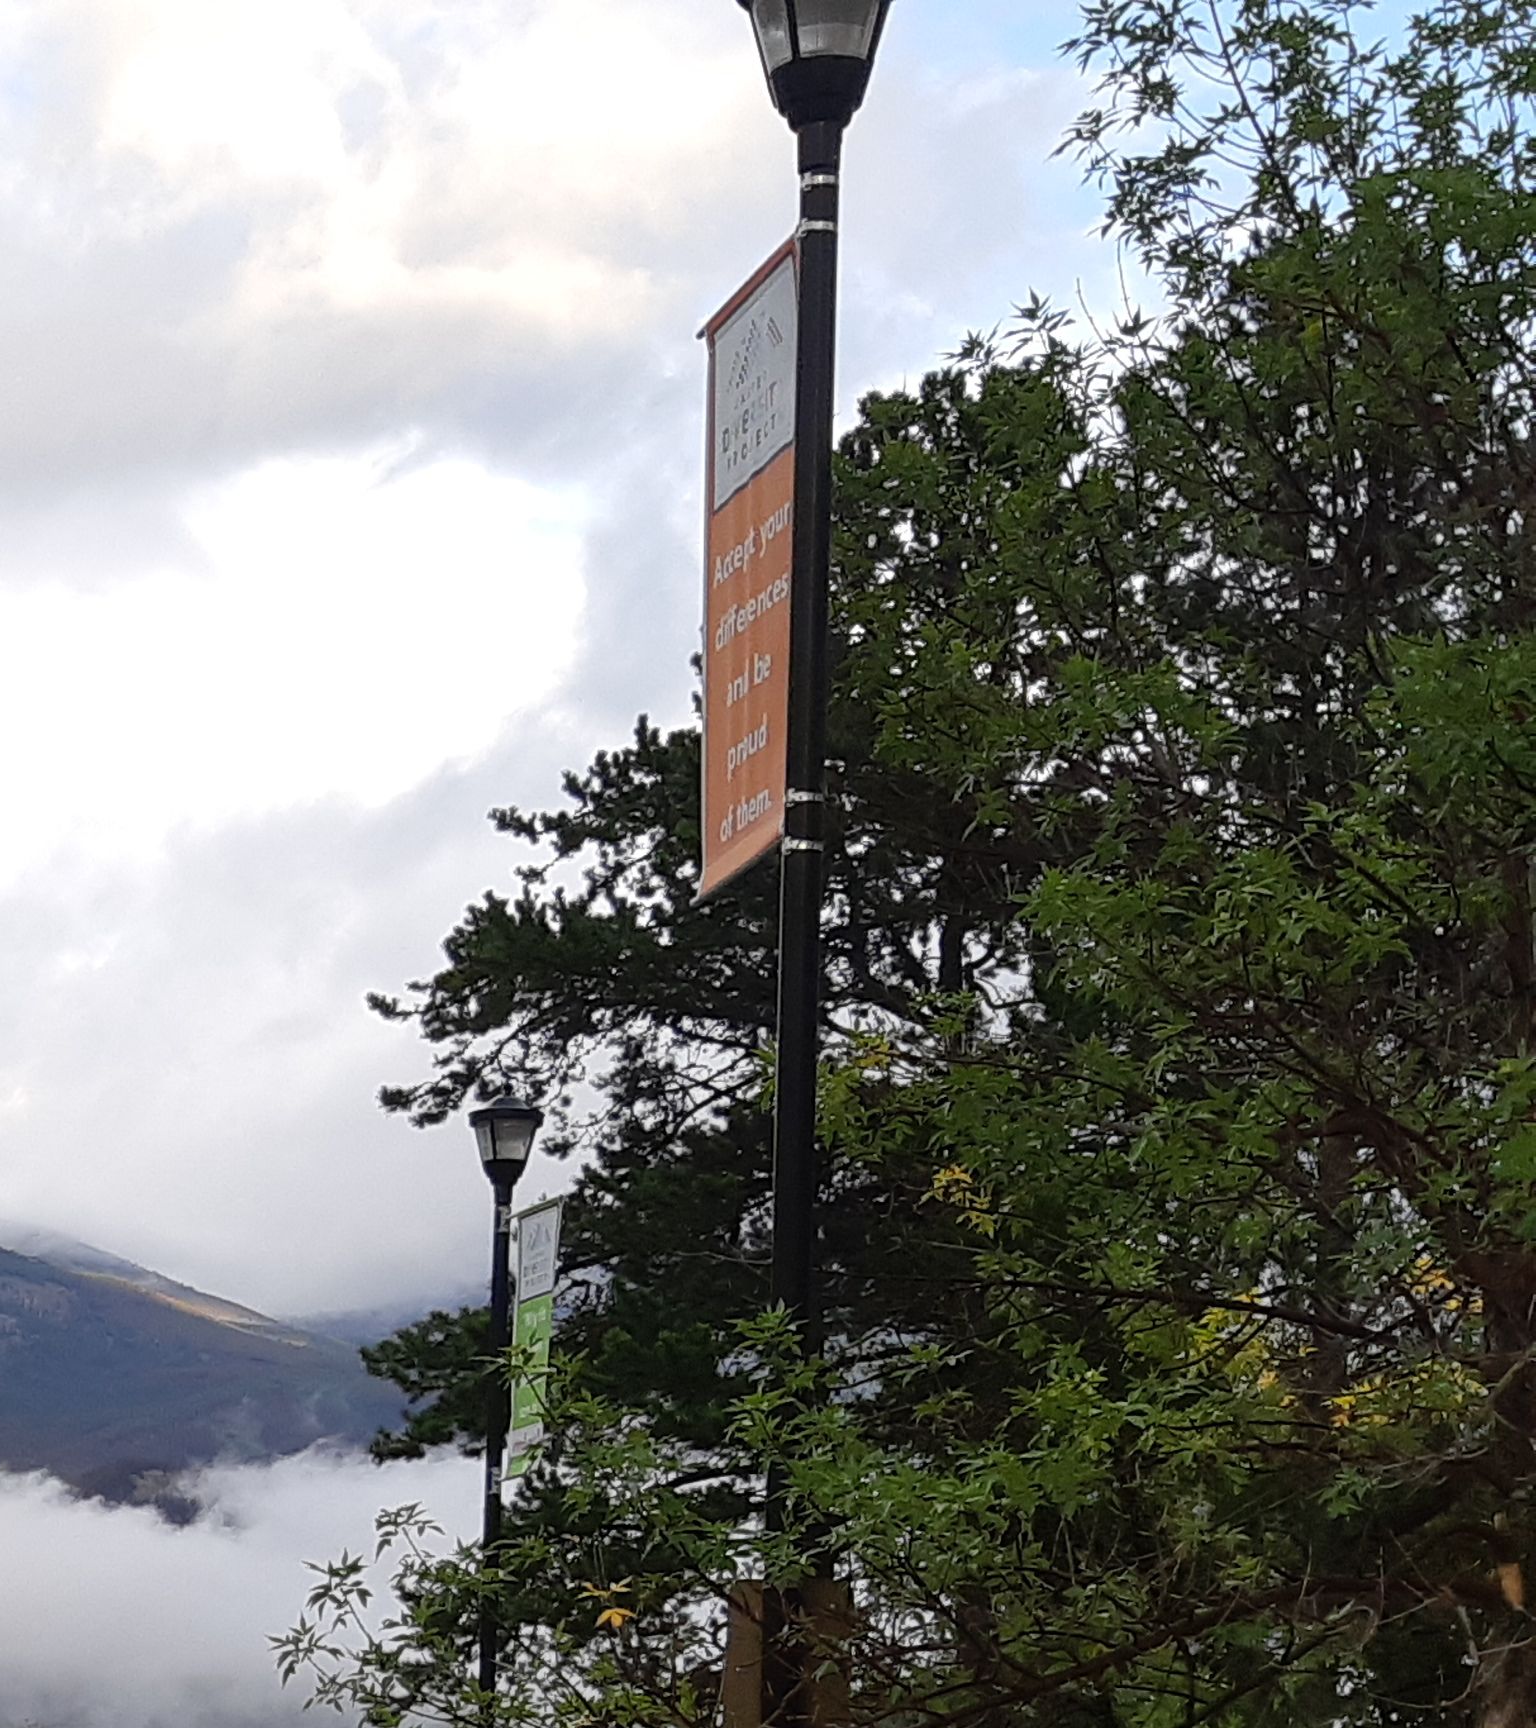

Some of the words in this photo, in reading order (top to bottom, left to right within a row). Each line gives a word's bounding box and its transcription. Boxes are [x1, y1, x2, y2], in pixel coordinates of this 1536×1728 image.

[714, 526, 756, 588] Accept
[759, 501, 792, 558] your
[714, 571, 790, 651] diffeences
[753, 652, 772, 686] be
[720, 804, 734, 843] of
